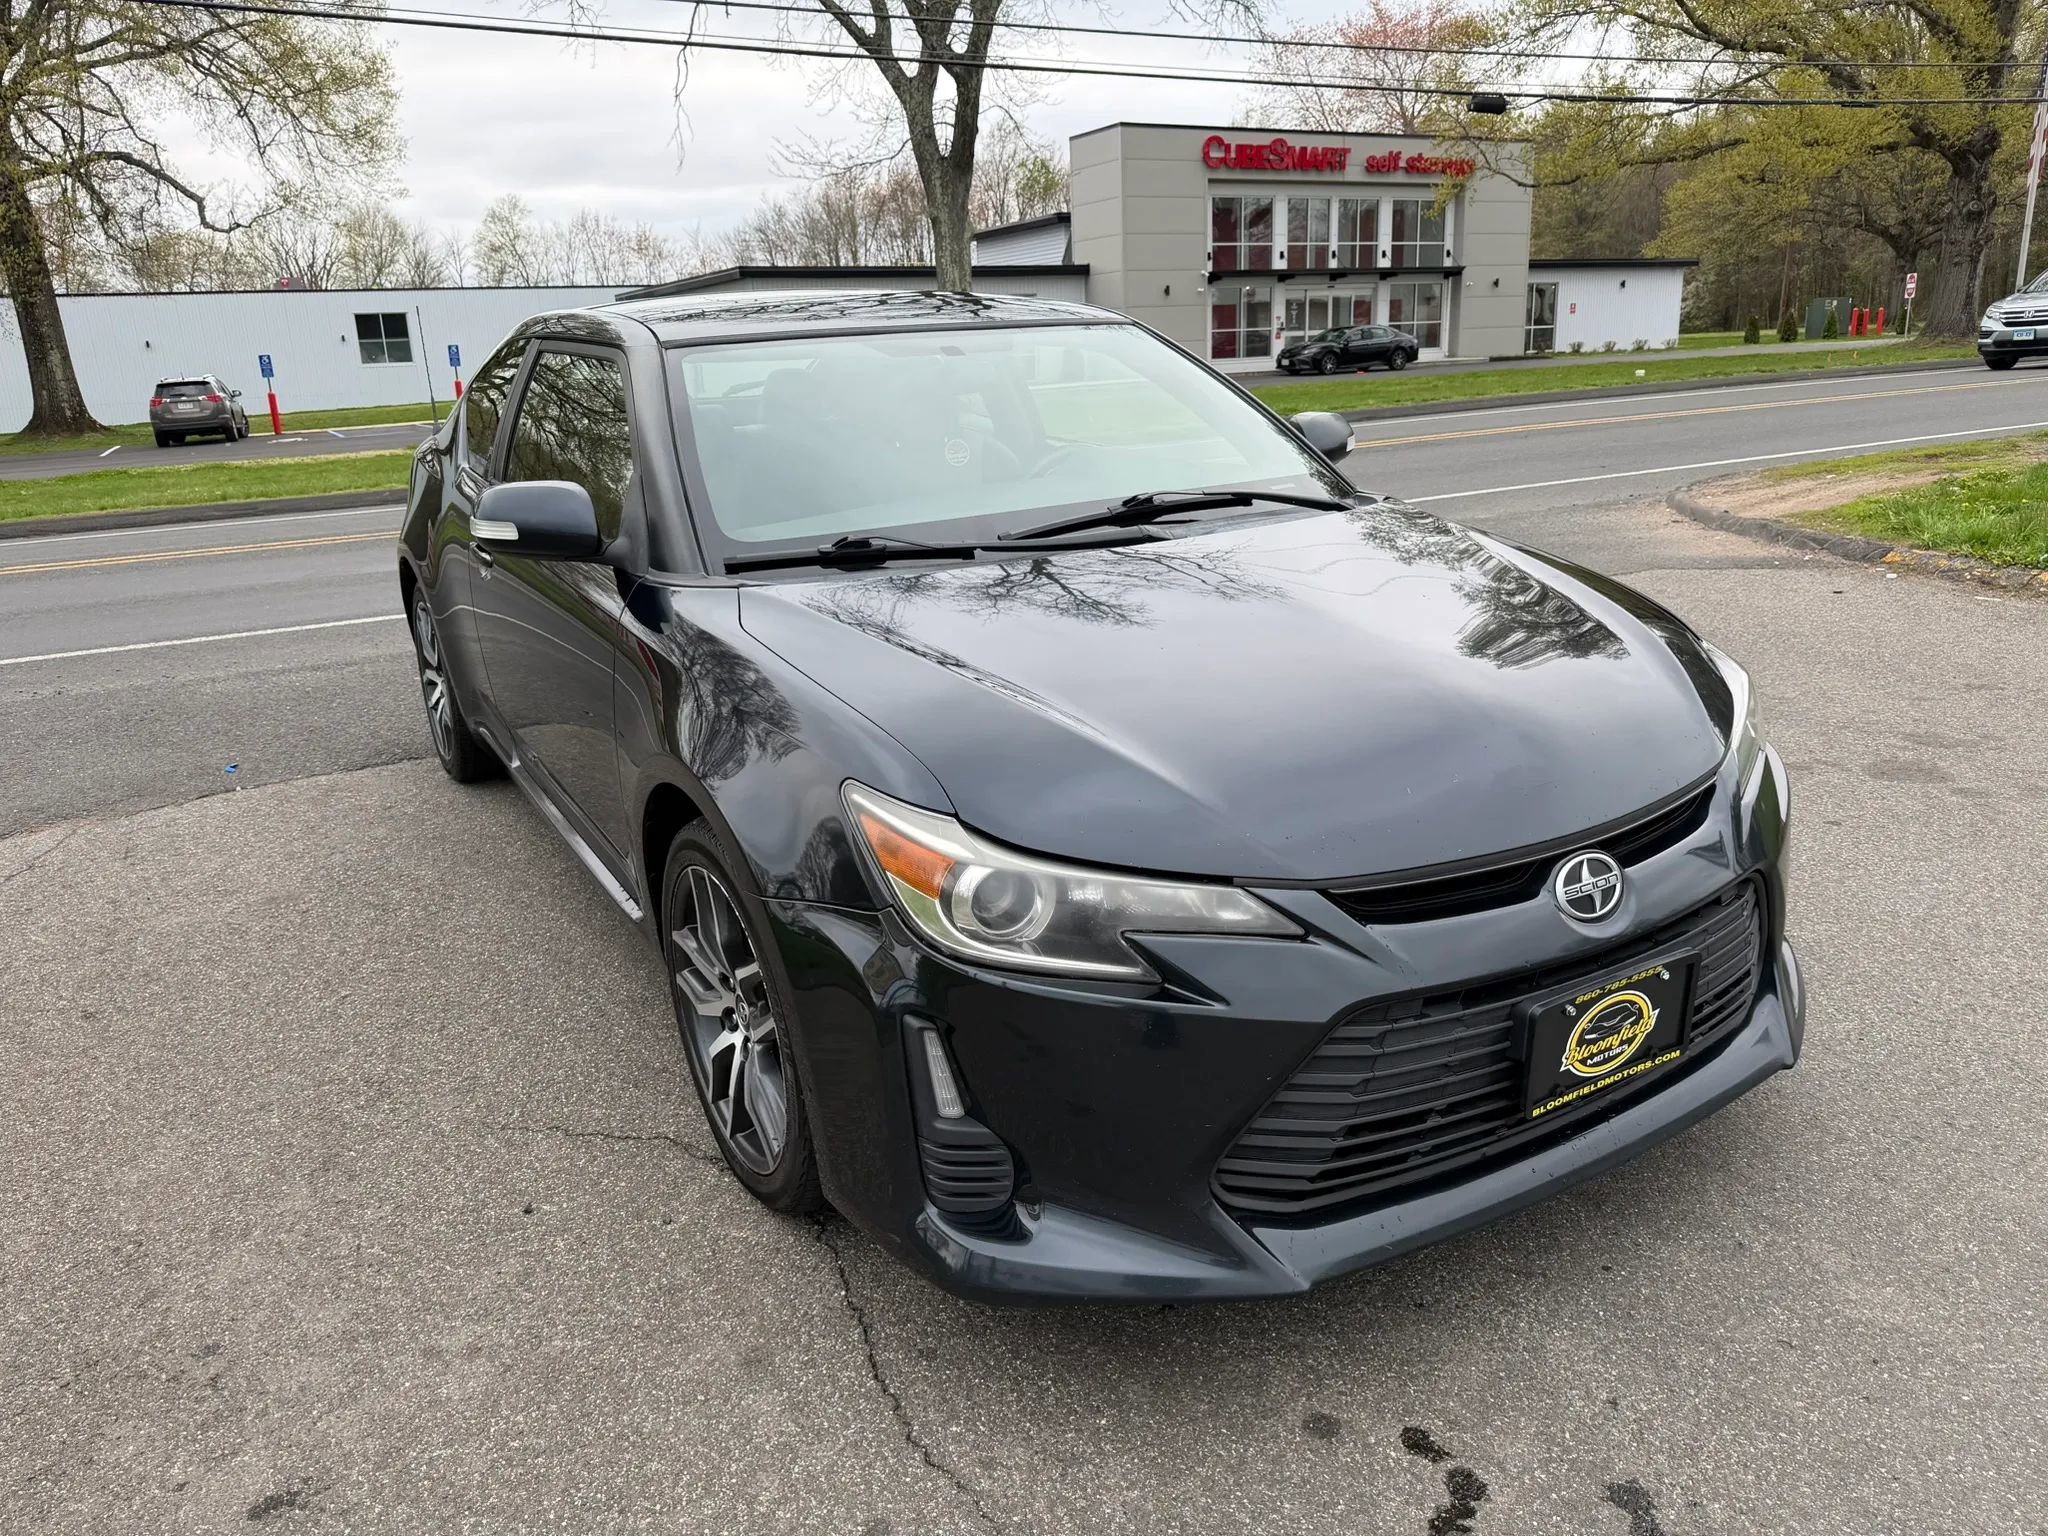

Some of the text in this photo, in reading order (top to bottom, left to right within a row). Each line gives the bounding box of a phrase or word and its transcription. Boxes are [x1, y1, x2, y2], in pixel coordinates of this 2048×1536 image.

[1366, 150, 1402, 173] self
[1567, 1014, 1654, 1064] Bloomfield
[1586, 1044, 1629, 1066] MOTORS
[1532, 1050, 1681, 1117] BLOOMFIELDMOTORS.COM
